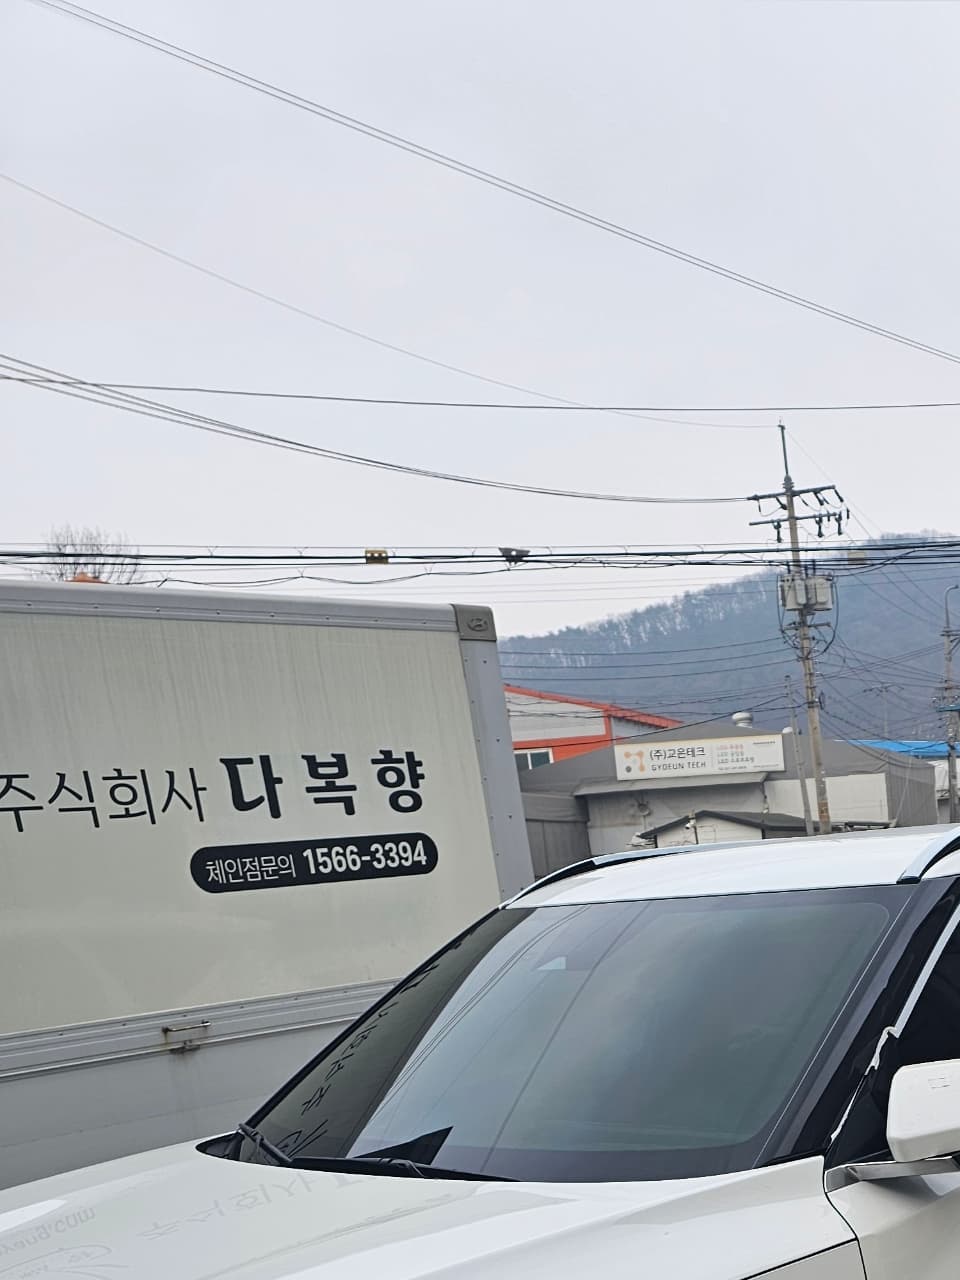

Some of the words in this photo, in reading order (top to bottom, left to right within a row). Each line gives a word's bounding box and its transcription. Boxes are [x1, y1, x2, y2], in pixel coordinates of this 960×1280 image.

[651, 763, 685, 771] GYOEUN
[687, 761, 706, 769] TECH
[0, 768, 207, 832] 주식회사
[219, 749, 425, 819] 다복향
[205, 854, 296, 884] 체인점문의
[302, 840, 427, 875] 1566-3394
